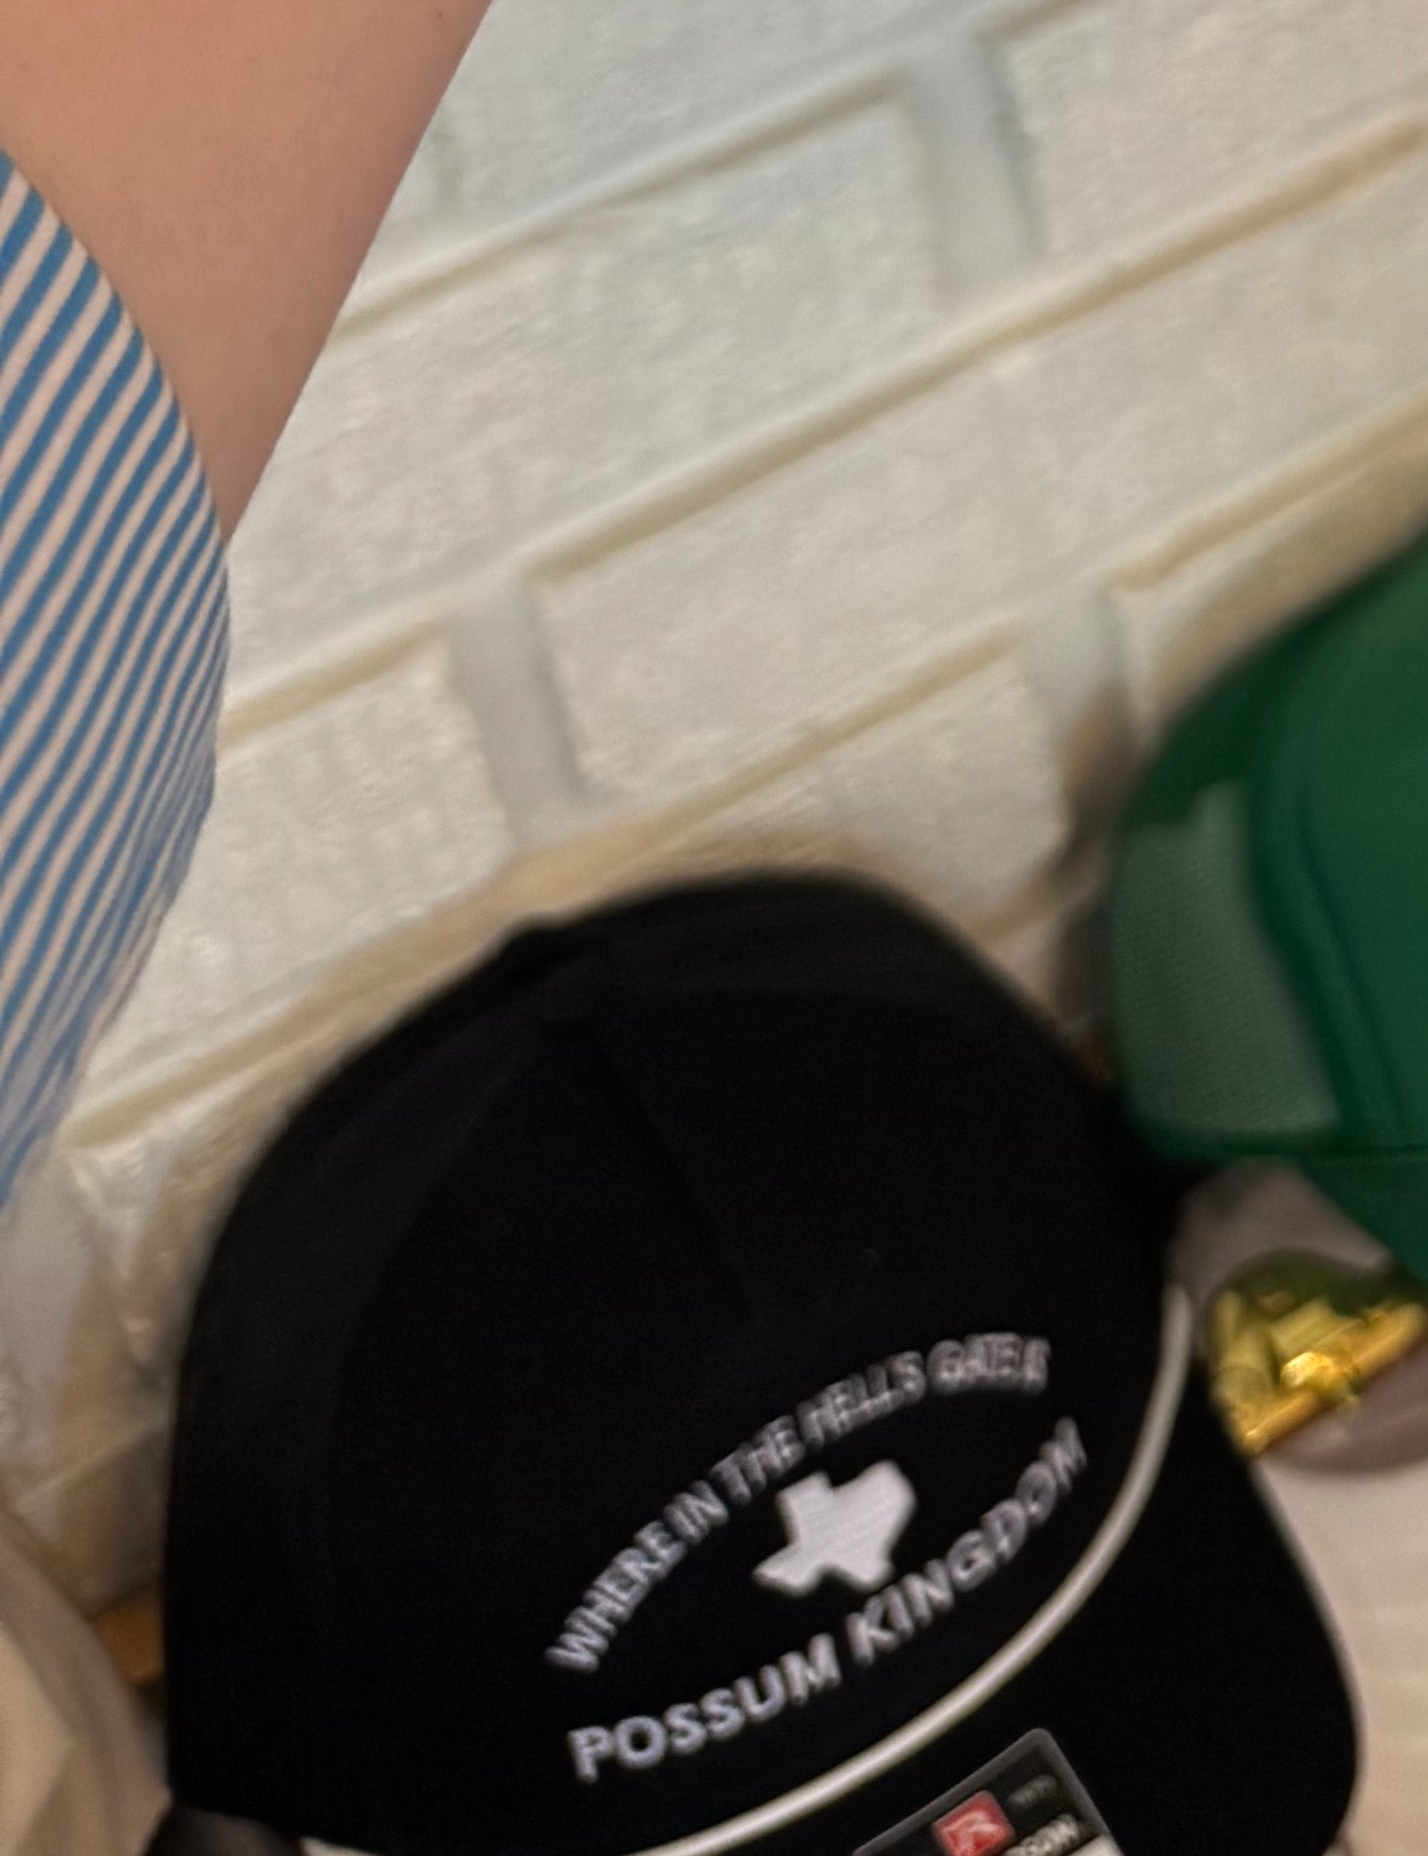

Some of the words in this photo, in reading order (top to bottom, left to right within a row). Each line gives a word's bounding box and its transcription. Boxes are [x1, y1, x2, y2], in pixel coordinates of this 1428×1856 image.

[544, 1520, 688, 1674] WHERE
[661, 1478, 731, 1546] IN
[709, 1413, 808, 1507] THE
[567, 1633, 844, 1784] POSSUM
[845, 1416, 1089, 1667] KINGDOM
